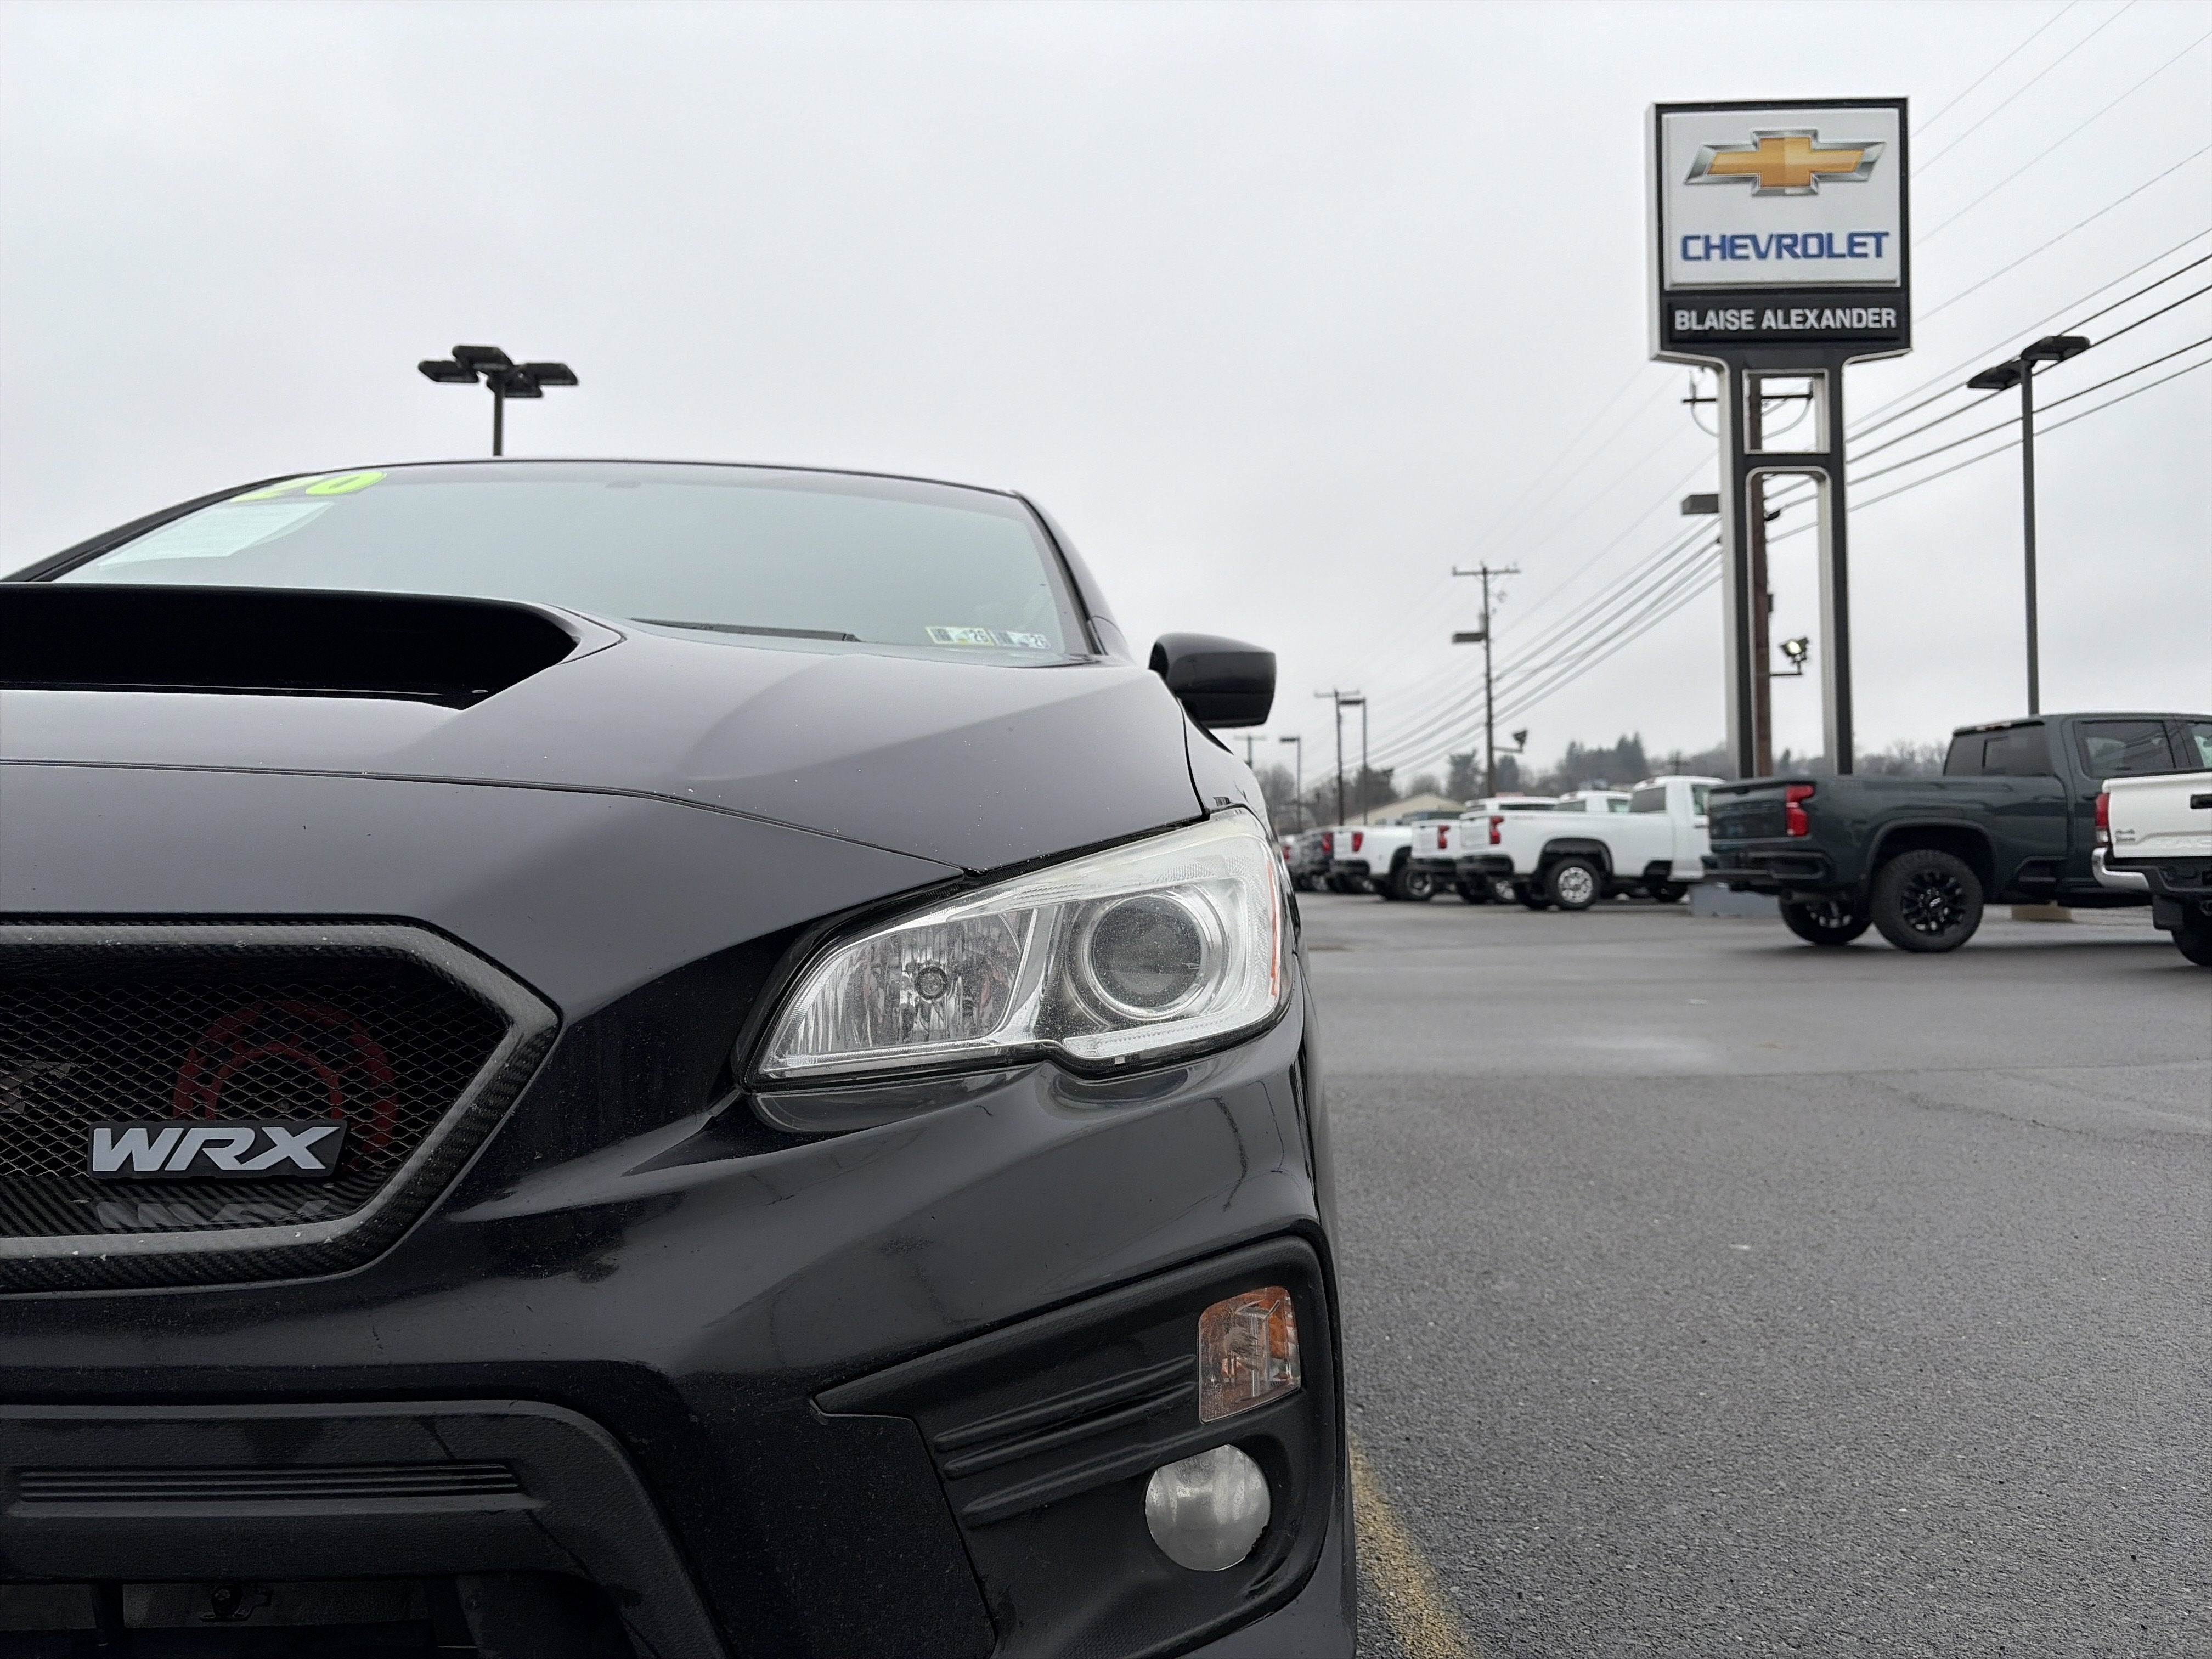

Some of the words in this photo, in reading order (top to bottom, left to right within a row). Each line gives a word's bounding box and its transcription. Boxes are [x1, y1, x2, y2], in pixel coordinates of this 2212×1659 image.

[1681, 232, 1889, 261] CHEVROLET
[1674, 309, 1755, 330] BLAISE
[1761, 307, 1897, 330] ALEXANDER
[92, 1126, 340, 1172] WRX
